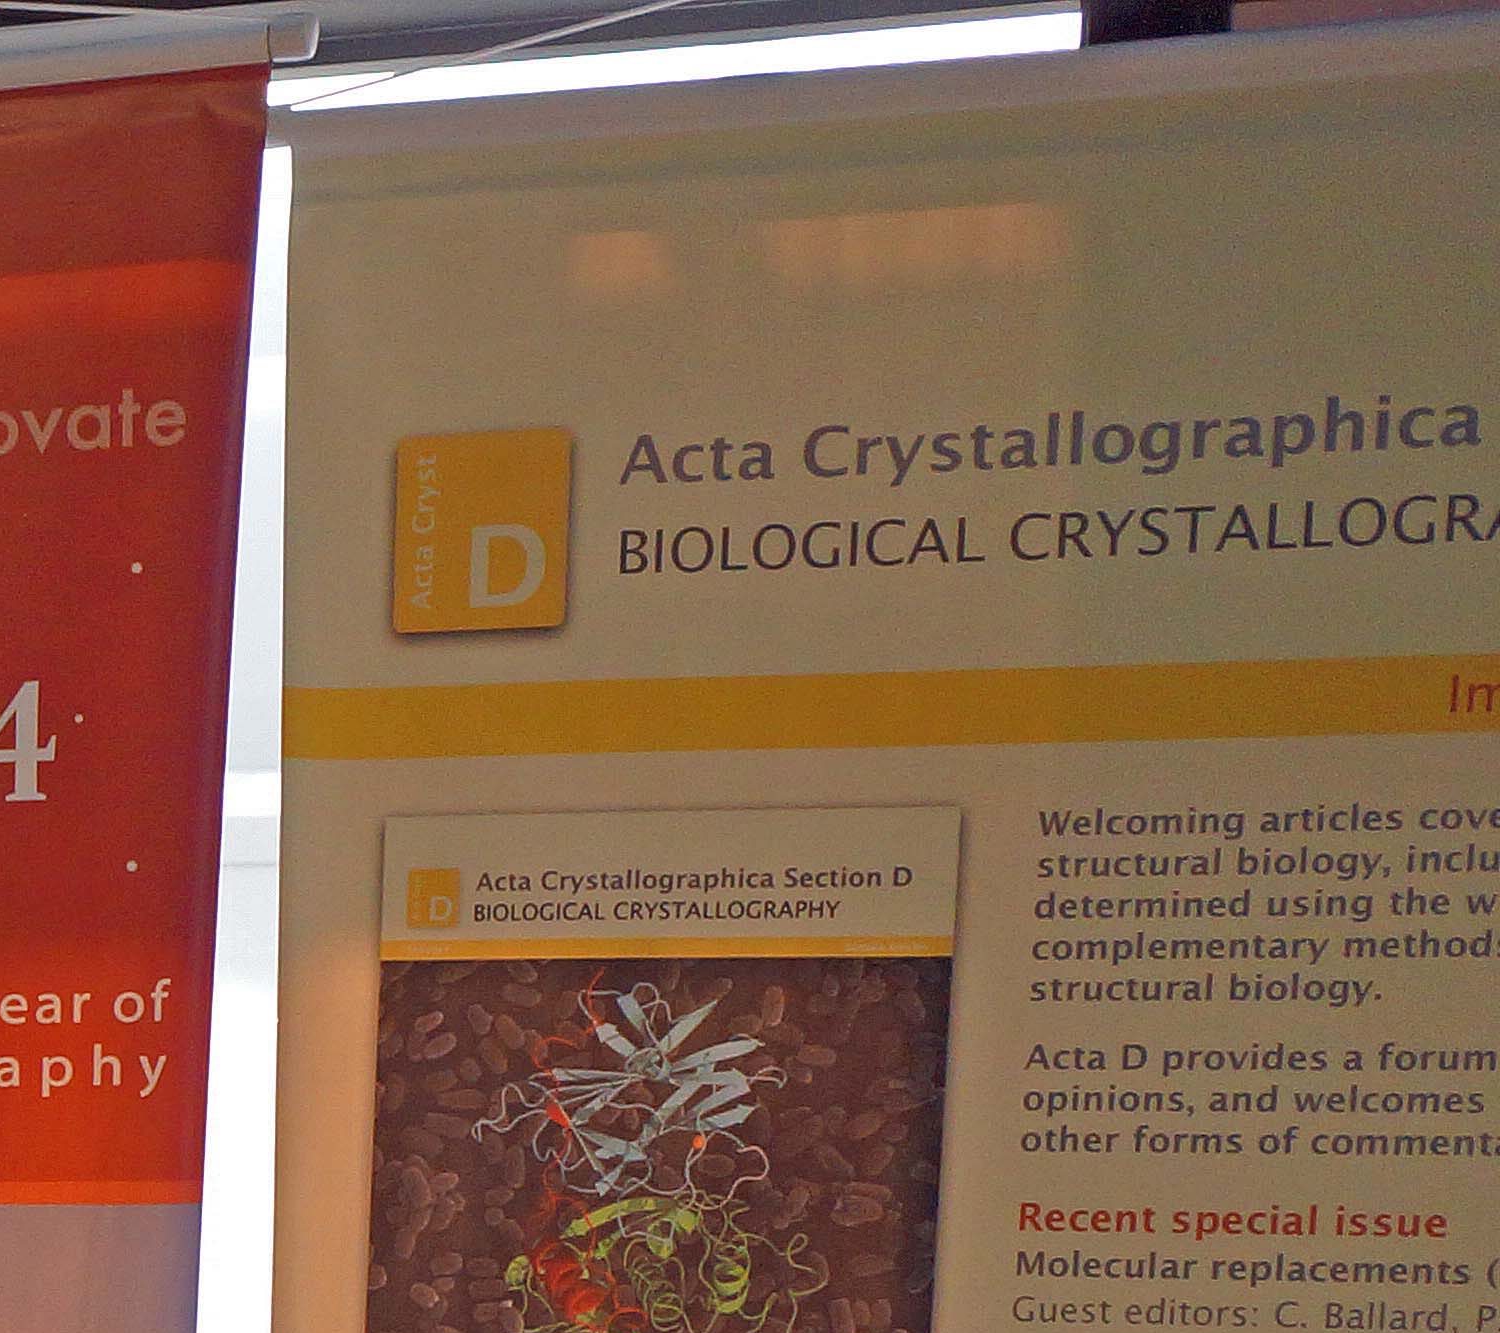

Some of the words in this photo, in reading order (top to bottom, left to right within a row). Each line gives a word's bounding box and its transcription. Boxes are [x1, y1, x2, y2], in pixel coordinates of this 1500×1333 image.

[620, 434, 774, 484] Acta
[804, 395, 1481, 486] Crystallographica
[620, 517, 985, 573] BIOLOGICAL
[1010, 494, 1500, 560] CRYSTALLOGR
[469, 523, 547, 608] D
[477, 872, 531, 891] Acta
[541, 867, 774, 894] Crystallographica
[785, 866, 881, 887] Section
[893, 866, 912, 885] D
[474, 902, 604, 921] BIOLOGICAL
[614, 900, 840, 920] CRYSTALLOGRAPHY
[114, 978, 171, 1022] of
[1019, 1202, 1155, 1232] Recent
[1172, 1204, 1317, 1240] special
[1336, 1205, 1446, 1237] issue
